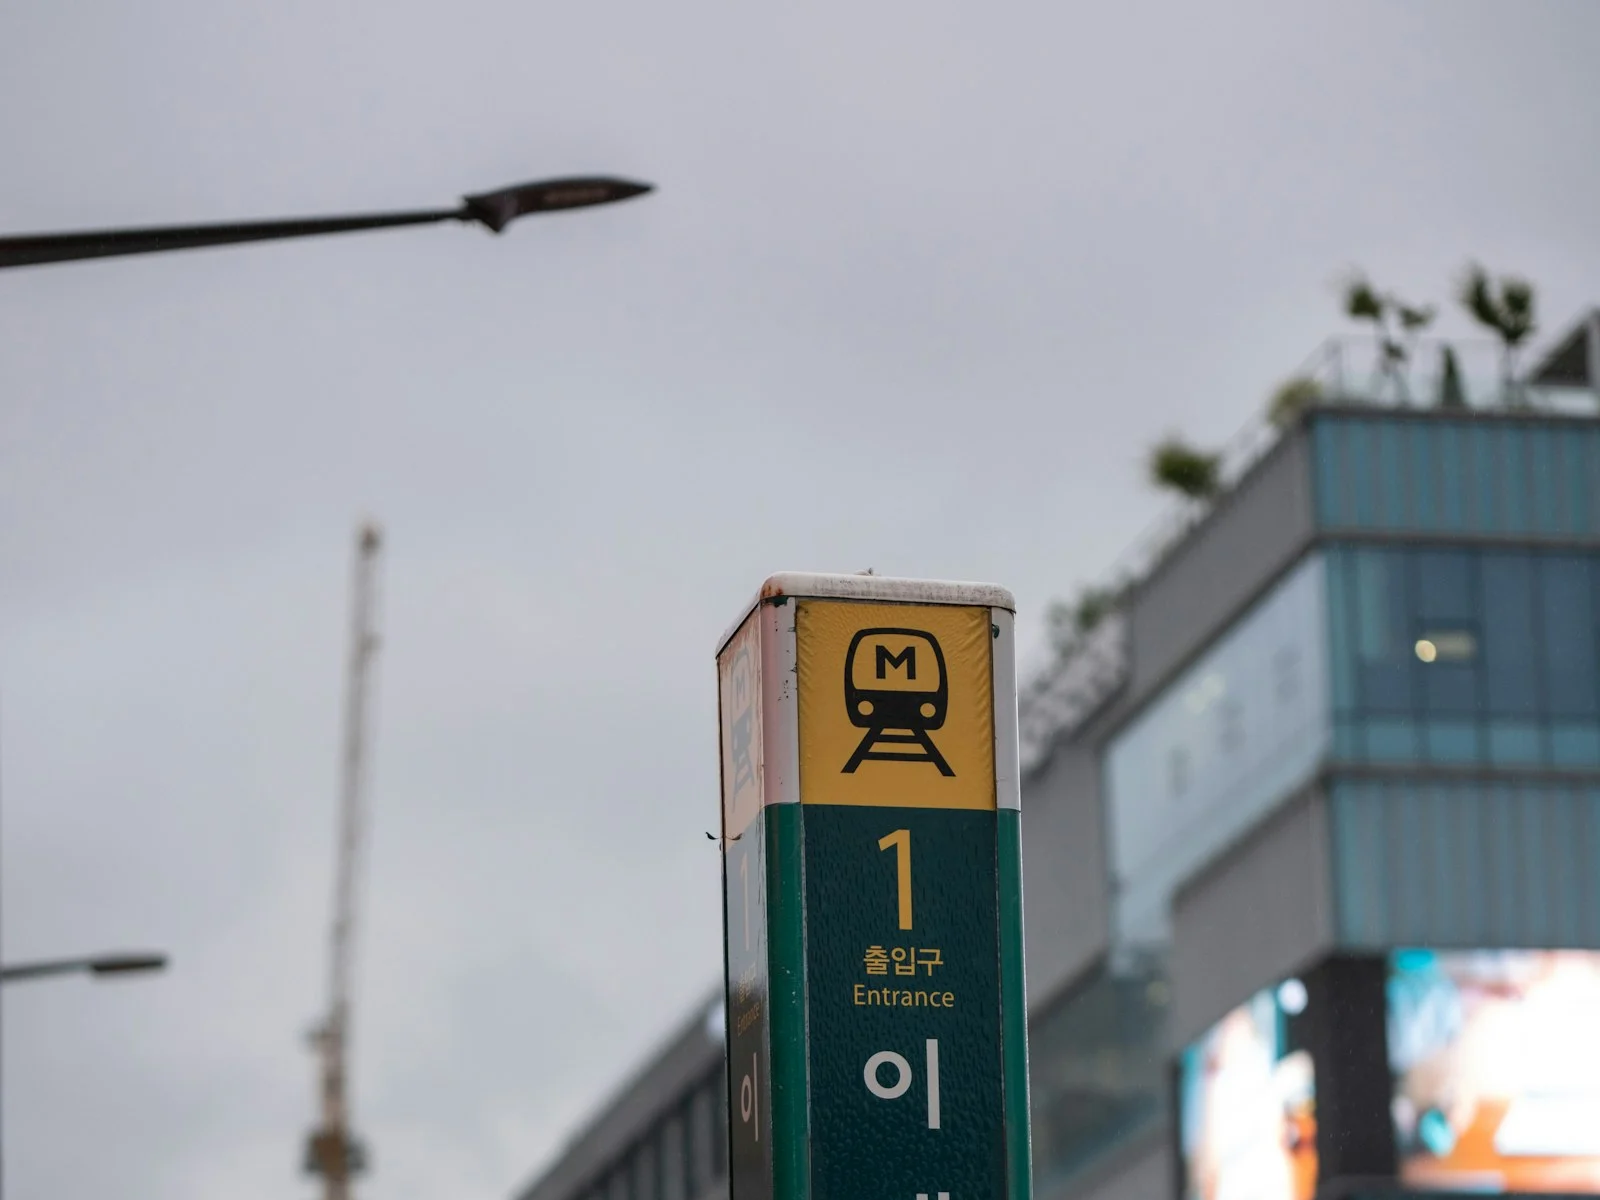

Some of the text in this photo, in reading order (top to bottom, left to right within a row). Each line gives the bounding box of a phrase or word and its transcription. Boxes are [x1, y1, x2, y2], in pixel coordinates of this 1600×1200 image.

[875, 645, 916, 680] M
[878, 829, 913, 930] 1
[740, 851, 750, 952] 1
[863, 945, 944, 977] 출입구
[854, 983, 955, 1008] Entrance
[737, 999, 760, 1037] Entrance
